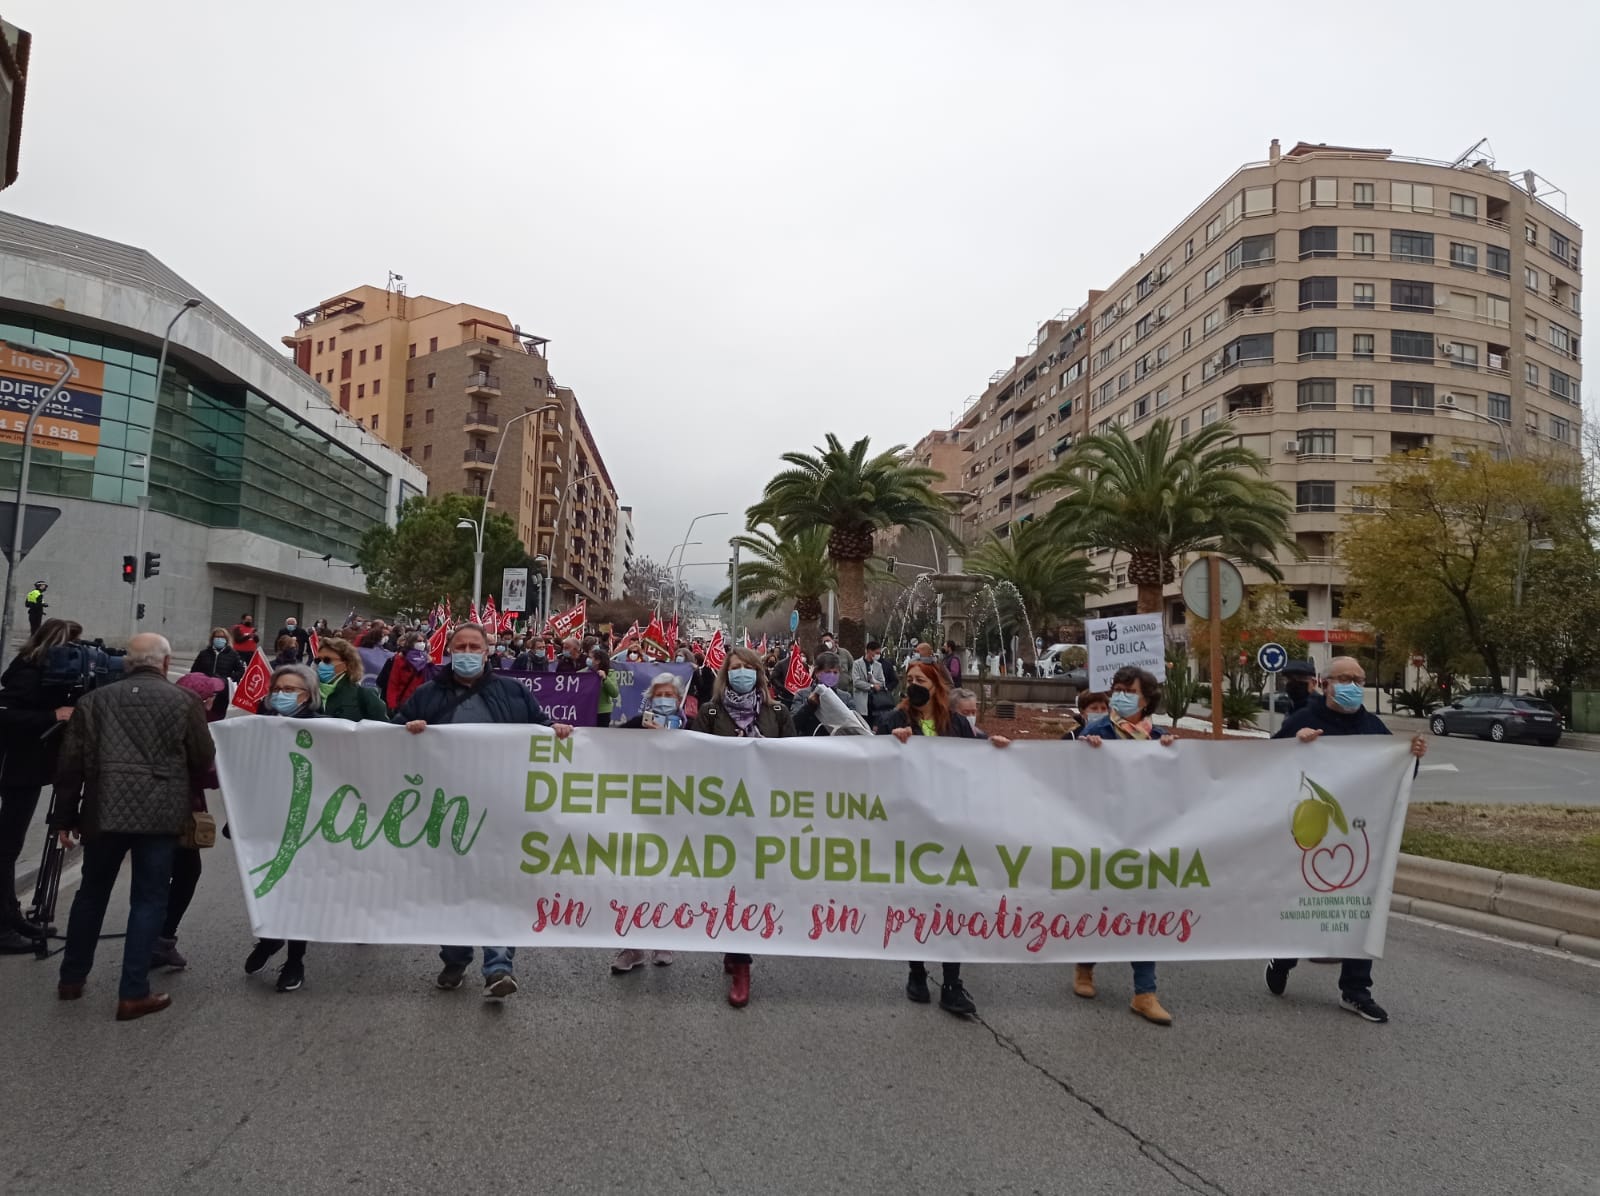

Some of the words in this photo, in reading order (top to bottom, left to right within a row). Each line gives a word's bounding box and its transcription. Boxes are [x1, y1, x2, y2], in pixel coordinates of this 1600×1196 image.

[11, 351, 80, 378] inerza
[0, 380, 71, 403] DIFICO
[49, 425, 79, 441] 858
[514, 677, 543, 693] TAS
[555, 675, 580, 692] 8M
[529, 735, 574, 763] EN
[524, 771, 755, 817] DEFENSA
[770, 790, 815, 818] DE
[826, 791, 889, 821] UNA
[520, 832, 737, 878] SANIDAD
[755, 824, 979, 887] PÚBLICA
[996, 845, 1033, 888] Y
[1051, 846, 1211, 890] DIGNA
[1299, 896, 1345, 906] PLATAFORMA
[1346, 896, 1361, 906] POR
[1362, 897, 1372, 906] LA
[532, 893, 592, 932] sin
[609, 886, 784, 939] recortes,
[808, 899, 867, 940] sin
[882, 895, 1201, 952] privatizaciones
[1280, 911, 1311, 920] SANIDAD
[1342, 910, 1348, 919] Y
[1349, 910, 1358, 919] DE
[1321, 923, 1330, 932] DE
